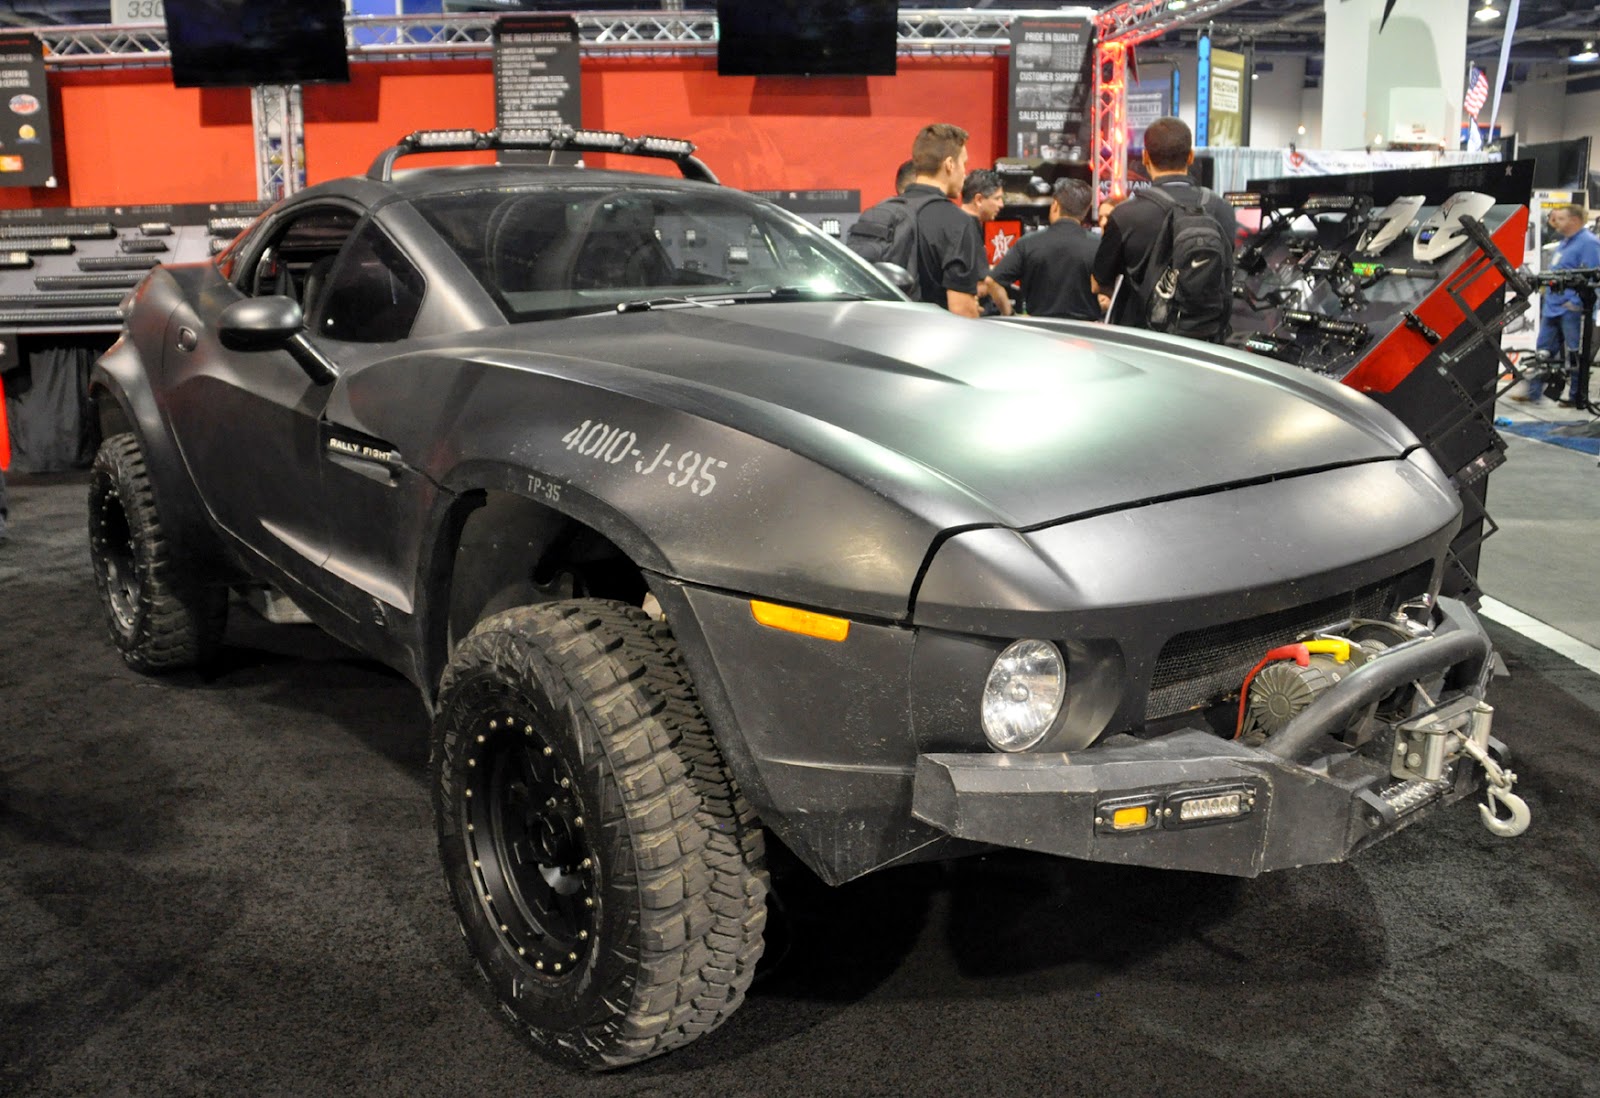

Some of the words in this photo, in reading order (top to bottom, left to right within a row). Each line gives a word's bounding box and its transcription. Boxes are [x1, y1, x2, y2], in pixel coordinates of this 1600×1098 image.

[532, 32, 572, 42] DIFFERENCE
[1025, 32, 1044, 41] PRIDE
[1045, 32, 1052, 42] IN
[1053, 33, 1080, 43] QUALITY
[1019, 72, 1054, 81] CUSTOMER
[1054, 72, 1082, 82] SUPPORT
[1018, 111, 1039, 120] SALES
[1045, 111, 1082, 121] MARKETING
[1036, 121, 1064, 130] SUPPORT
[329, 438, 358, 453] RALLY
[561, 419, 728, 497] 4010-J-95
[527, 474, 562, 502] TP-35
